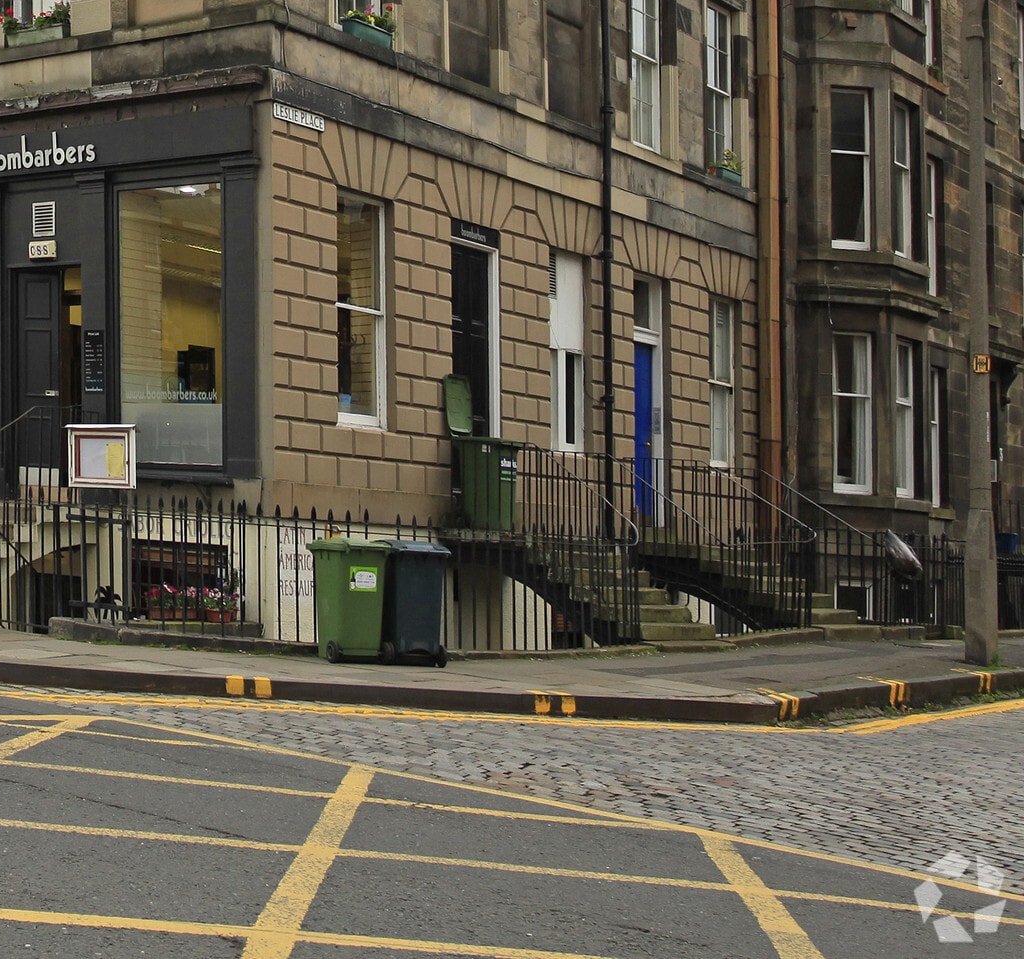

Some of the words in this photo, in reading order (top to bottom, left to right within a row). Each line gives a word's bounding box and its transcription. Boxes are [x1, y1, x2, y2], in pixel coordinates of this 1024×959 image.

[275, 103, 299, 121] LESLIE
[300, 111, 324, 129] PLACE
[125, 382, 218, 401] www.boombarbers.co.uk
